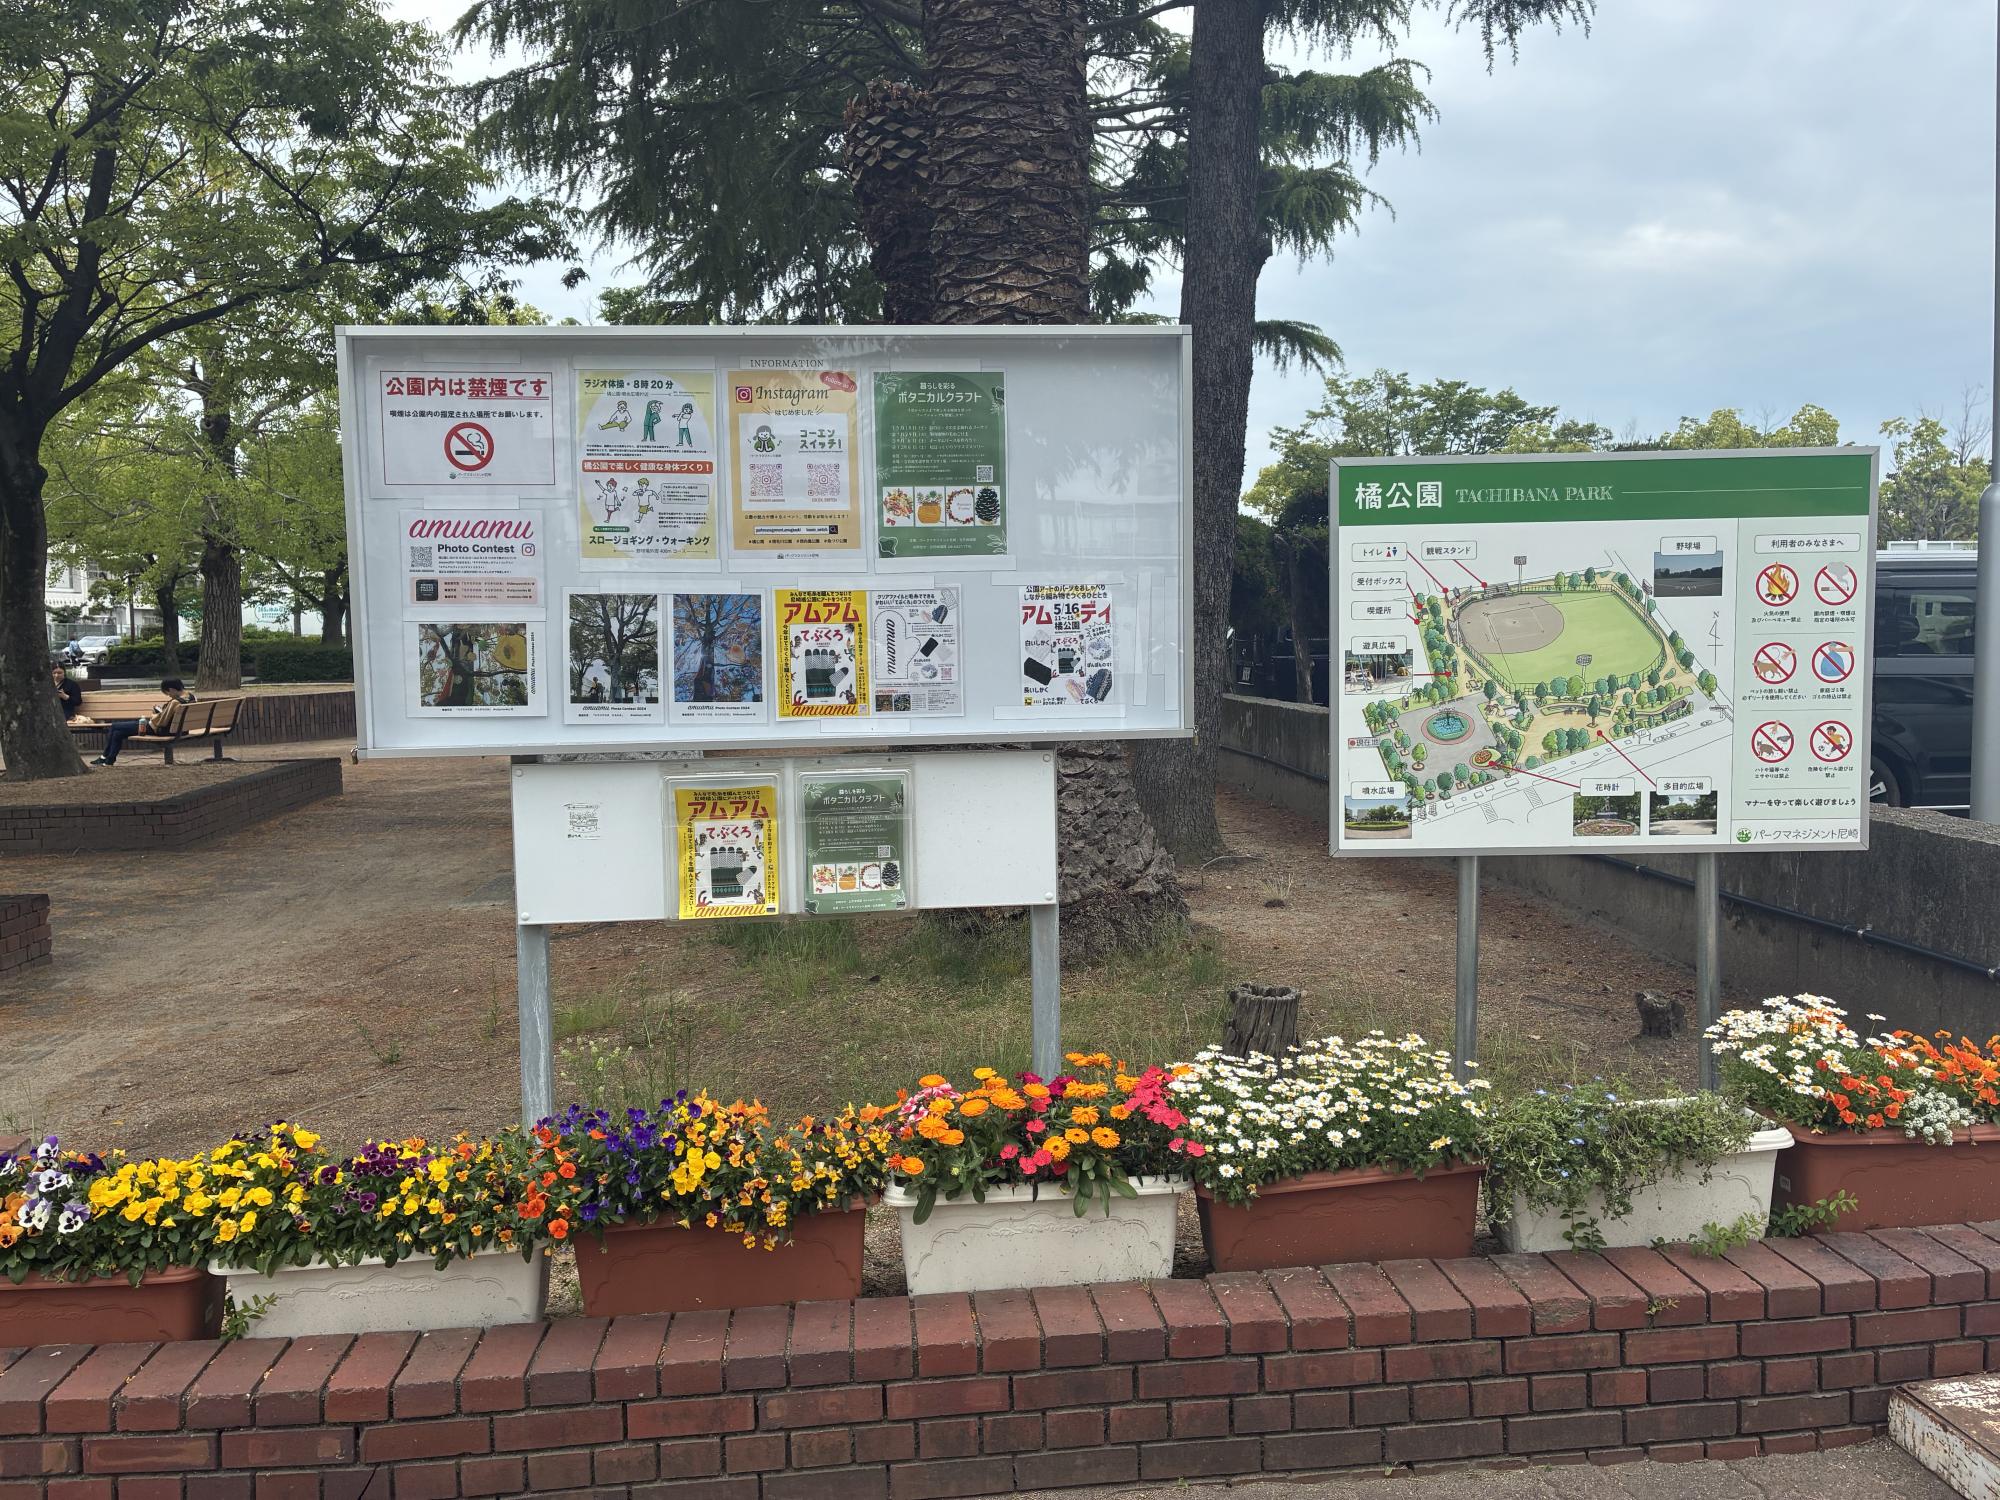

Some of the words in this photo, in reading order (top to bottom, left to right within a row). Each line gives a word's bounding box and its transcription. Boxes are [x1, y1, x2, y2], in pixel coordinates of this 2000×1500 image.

[750, 360, 824, 368] INFORMATION
[386, 377, 548, 396] 公園内は禁煙です
[755, 386, 829, 406] Instagram
[898, 392, 982, 403] ボタニカルクラフト
[390, 410, 543, 418] 喫煙は公園内の指定された場所でお願いします。
[800, 429, 835, 438] コーエン
[584, 462, 710, 471] 橘公園で楽しく健康な身体づくり！
[1355, 481, 1442, 509] 橘公園
[1456, 488, 1558, 503] TACHIBANA
[1566, 486, 1614, 501] PARK
[409, 520, 534, 539] amuamu
[589, 536, 710, 546] スロージョギング・ウォーキング
[1676, 542, 1701, 550] 野球場
[1771, 539, 1844, 548] 利用者のみなさまへ
[437, 544, 469, 553] Photo
[472, 544, 515, 553] Contest
[1426, 546, 1471, 555] 観戦スタンド
[1356, 577, 1402, 586] 受付ボックス
[1026, 584, 1106, 593] 公園アートのパーツをおしゃべり
[784, 602, 860, 623] アムアム
[1054, 603, 1079, 615] 5/16
[1022, 605, 1053, 624] アム
[1054, 621, 1080, 630] 橘公園
[801, 630, 843, 641] てぶくろ
[1362, 641, 1396, 649] 遊具広場
[792, 705, 857, 716] amuamu
[1357, 738, 1379, 746] 現在地
[1595, 782, 1620, 792] 花時計
[1664, 782, 1704, 791] 多目的広場
[823, 795, 886, 805] ボタニカルクラフト
[1745, 799, 1857, 807] マナーを守って楽しく遊びましょう
[688, 800, 769, 821] アムアム
[706, 826, 751, 839] てぶくろ
[1754, 828, 1859, 840] パークマネジメント尼崎
[695, 905, 766, 917] amuamu
